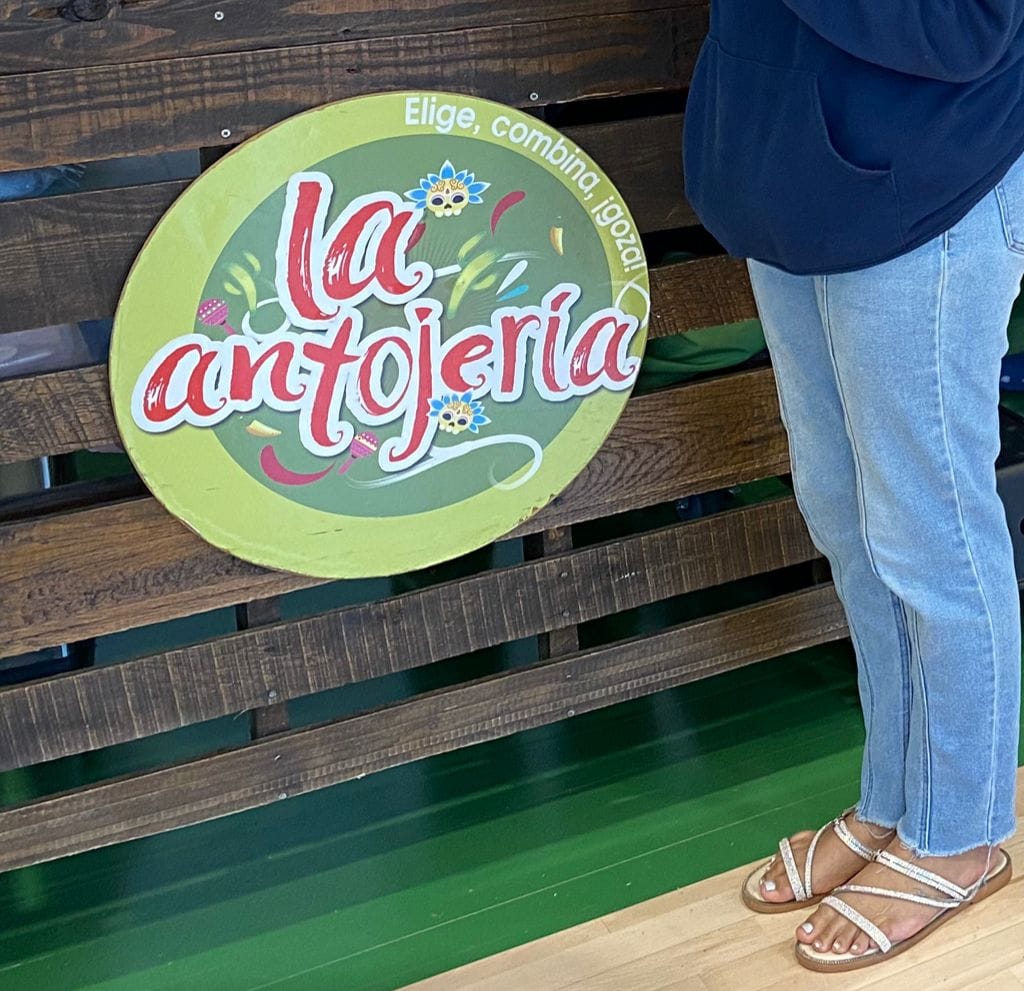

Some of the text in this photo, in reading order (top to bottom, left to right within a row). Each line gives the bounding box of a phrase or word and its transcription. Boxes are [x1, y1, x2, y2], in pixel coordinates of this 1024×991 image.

[405, 96, 480, 135] Elige,
[491, 116, 600, 200] combina,
[281, 176, 428, 324] la
[136, 287, 639, 467] antojería
